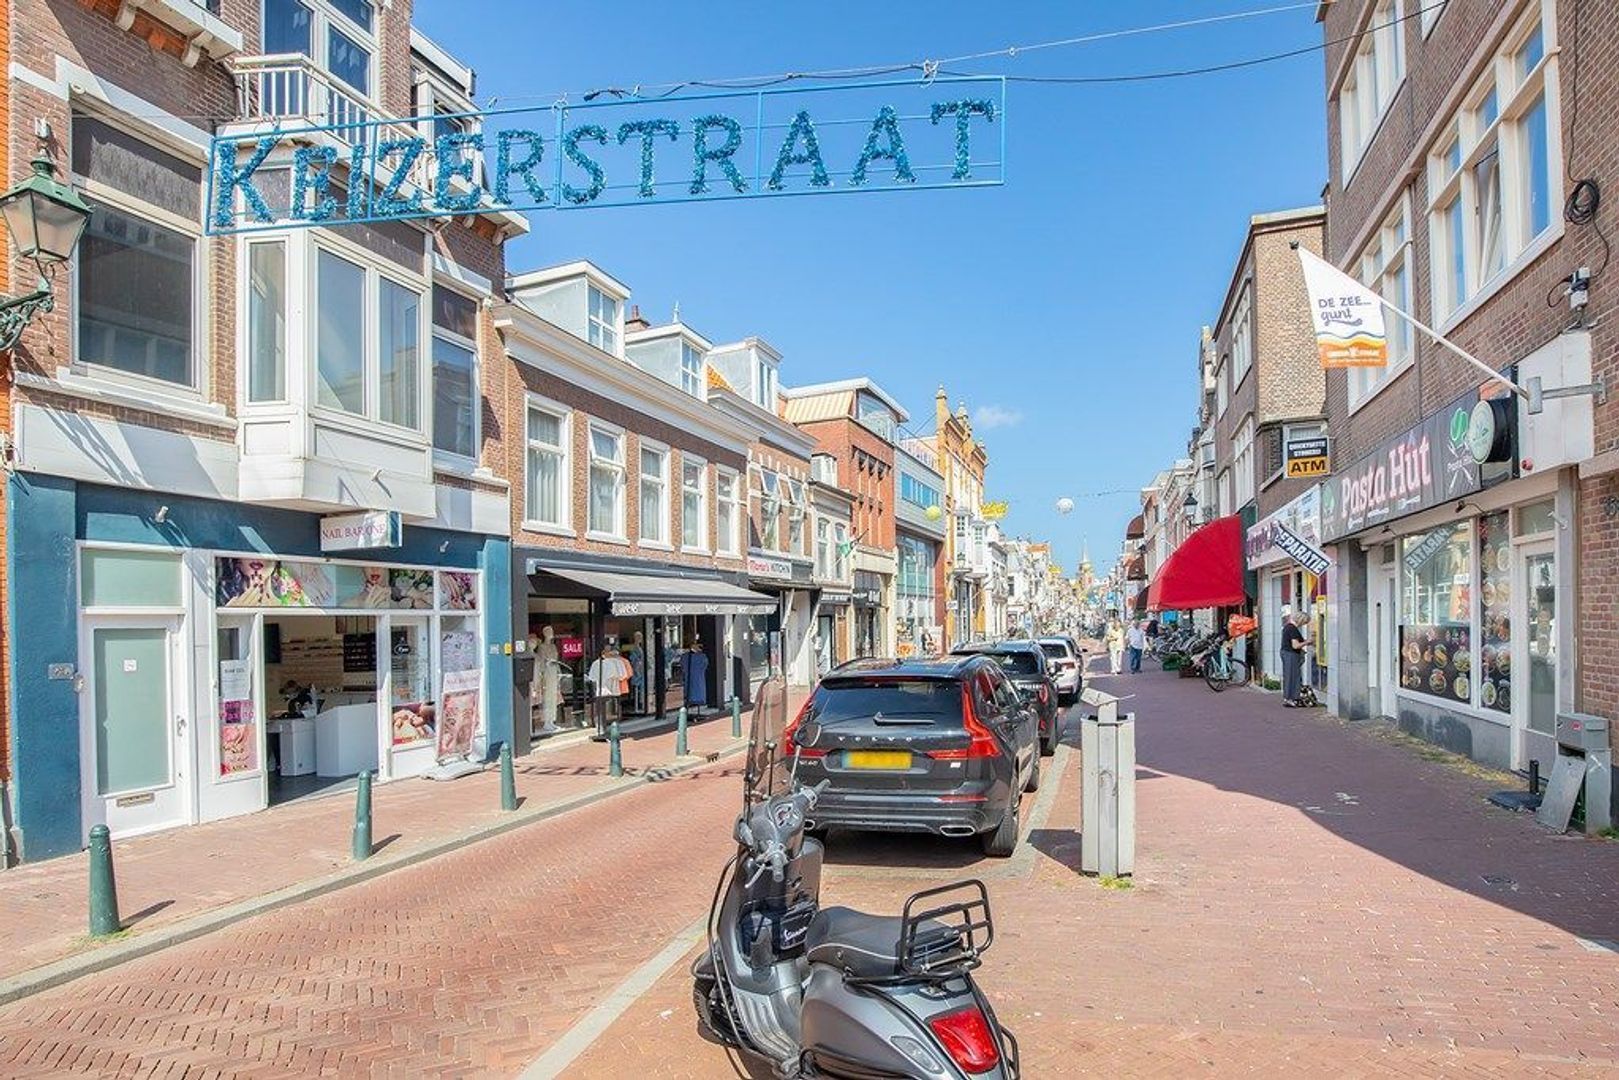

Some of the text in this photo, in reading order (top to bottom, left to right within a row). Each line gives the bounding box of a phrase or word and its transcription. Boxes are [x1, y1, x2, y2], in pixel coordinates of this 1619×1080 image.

[213, 98, 996, 230] KEIZERSTRAAT
[1318, 298, 1335, 308] DE
[1290, 460, 1326, 473] ATM
[1341, 465, 1387, 519] Pasta
[322, 523, 386, 540] NAIL BAR ONE
[563, 643, 582, 653] SALE
